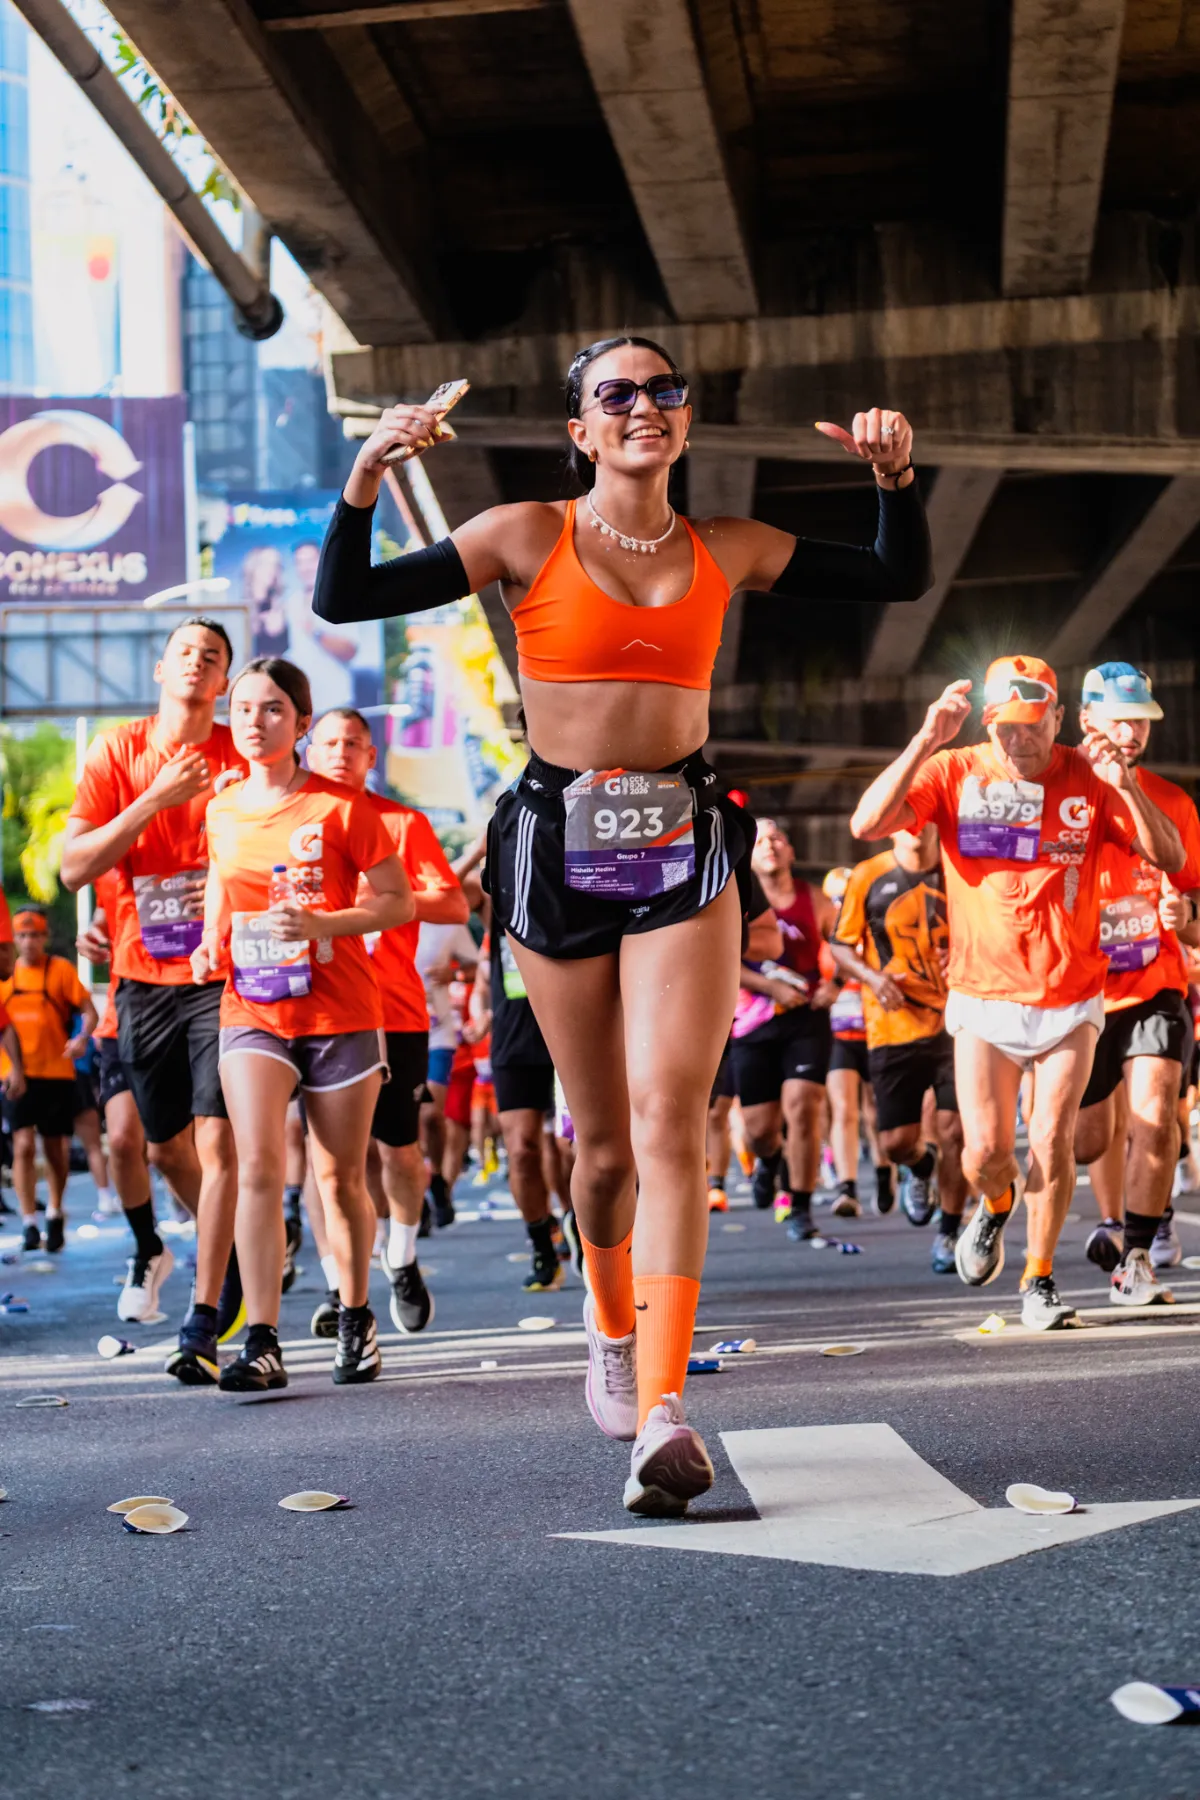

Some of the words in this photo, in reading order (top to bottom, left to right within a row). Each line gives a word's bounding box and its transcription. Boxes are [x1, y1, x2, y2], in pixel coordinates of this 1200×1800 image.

[0, 551, 148, 584] ONEXUS
[594, 807, 663, 840] 923
[289, 823, 324, 862] G
[286, 866, 324, 883] CCS
[1100, 914, 1154, 942] 0489
